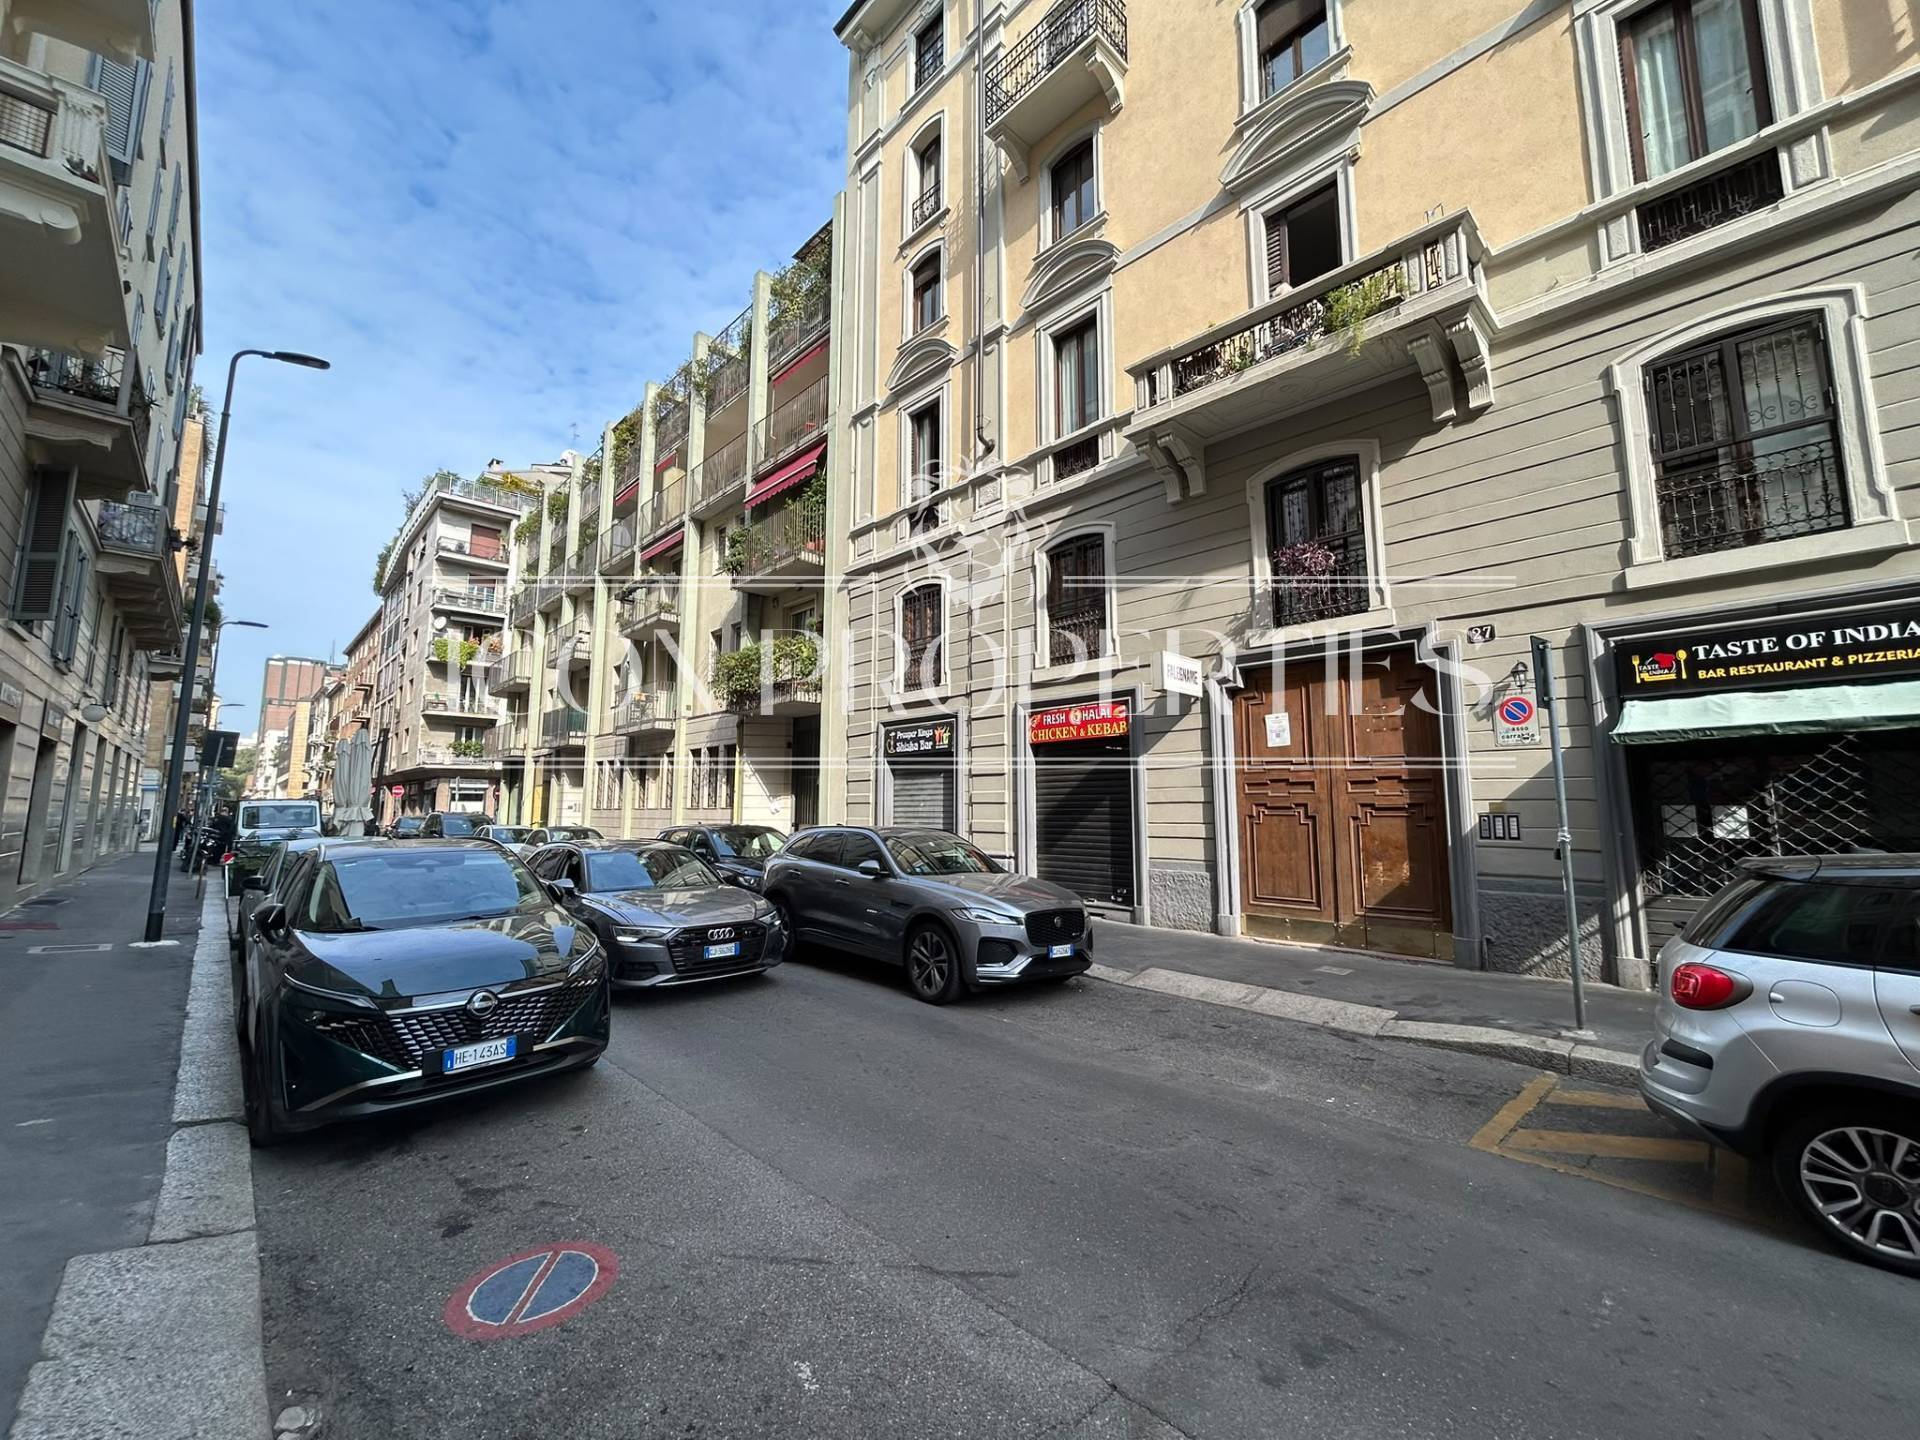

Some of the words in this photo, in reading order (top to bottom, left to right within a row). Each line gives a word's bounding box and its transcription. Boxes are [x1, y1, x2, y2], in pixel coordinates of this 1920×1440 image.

[1472, 626, 1492, 641] 27
[1692, 637, 1780, 661] TASTE
[1786, 631, 1827, 650] OF
[1831, 620, 1920, 645] INDIA
[1698, 667, 1727, 679] BAR
[1730, 657, 1828, 676] RESTAURANT
[1831, 655, 1845, 666] &
[1848, 648, 1920, 664] PIZZERIA
[1043, 713, 1066, 725] FRESH
[1082, 708, 1112, 721] HALAL
[1031, 726, 1077, 741] CHICKEN
[1080, 728, 1085, 737] &
[1087, 721, 1128, 736] KEBAB
[919, 740, 933, 751] Bar
